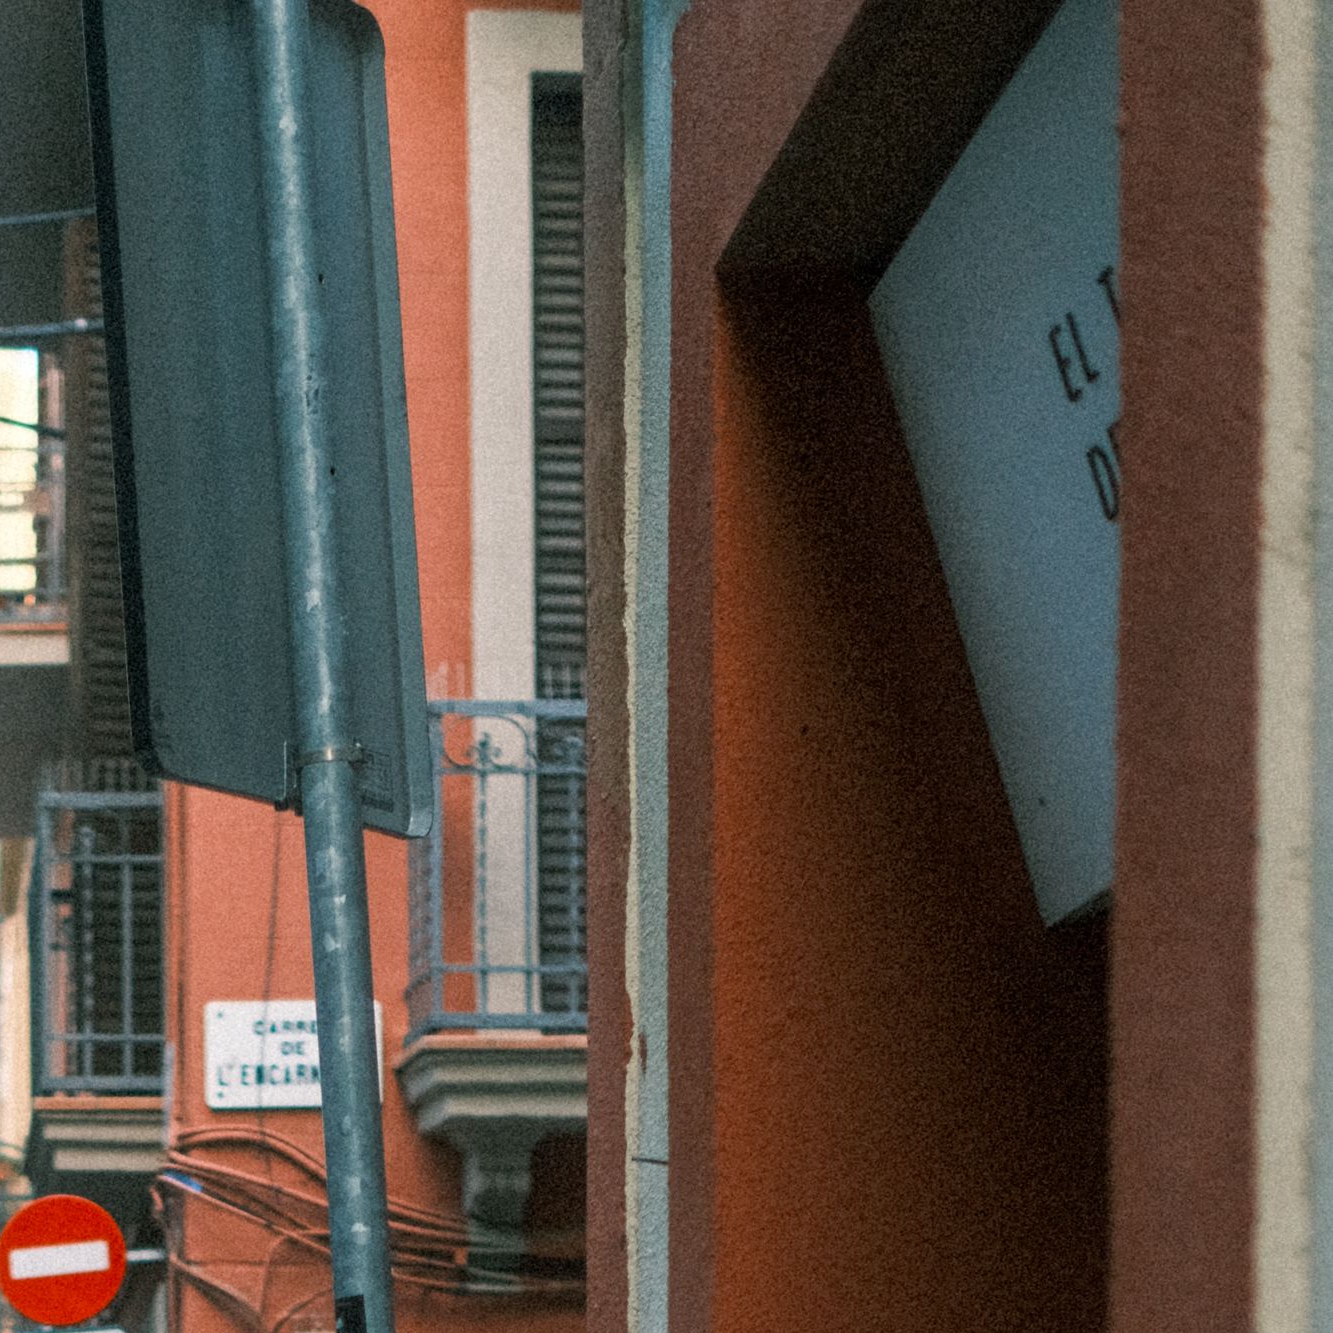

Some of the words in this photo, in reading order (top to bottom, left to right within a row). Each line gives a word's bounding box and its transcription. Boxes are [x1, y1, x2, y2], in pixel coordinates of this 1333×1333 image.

[253, 1019, 318, 1035] CARRE
[281, 1040, 305, 1055] DE
[217, 1063, 321, 1086] L'ENCARN
